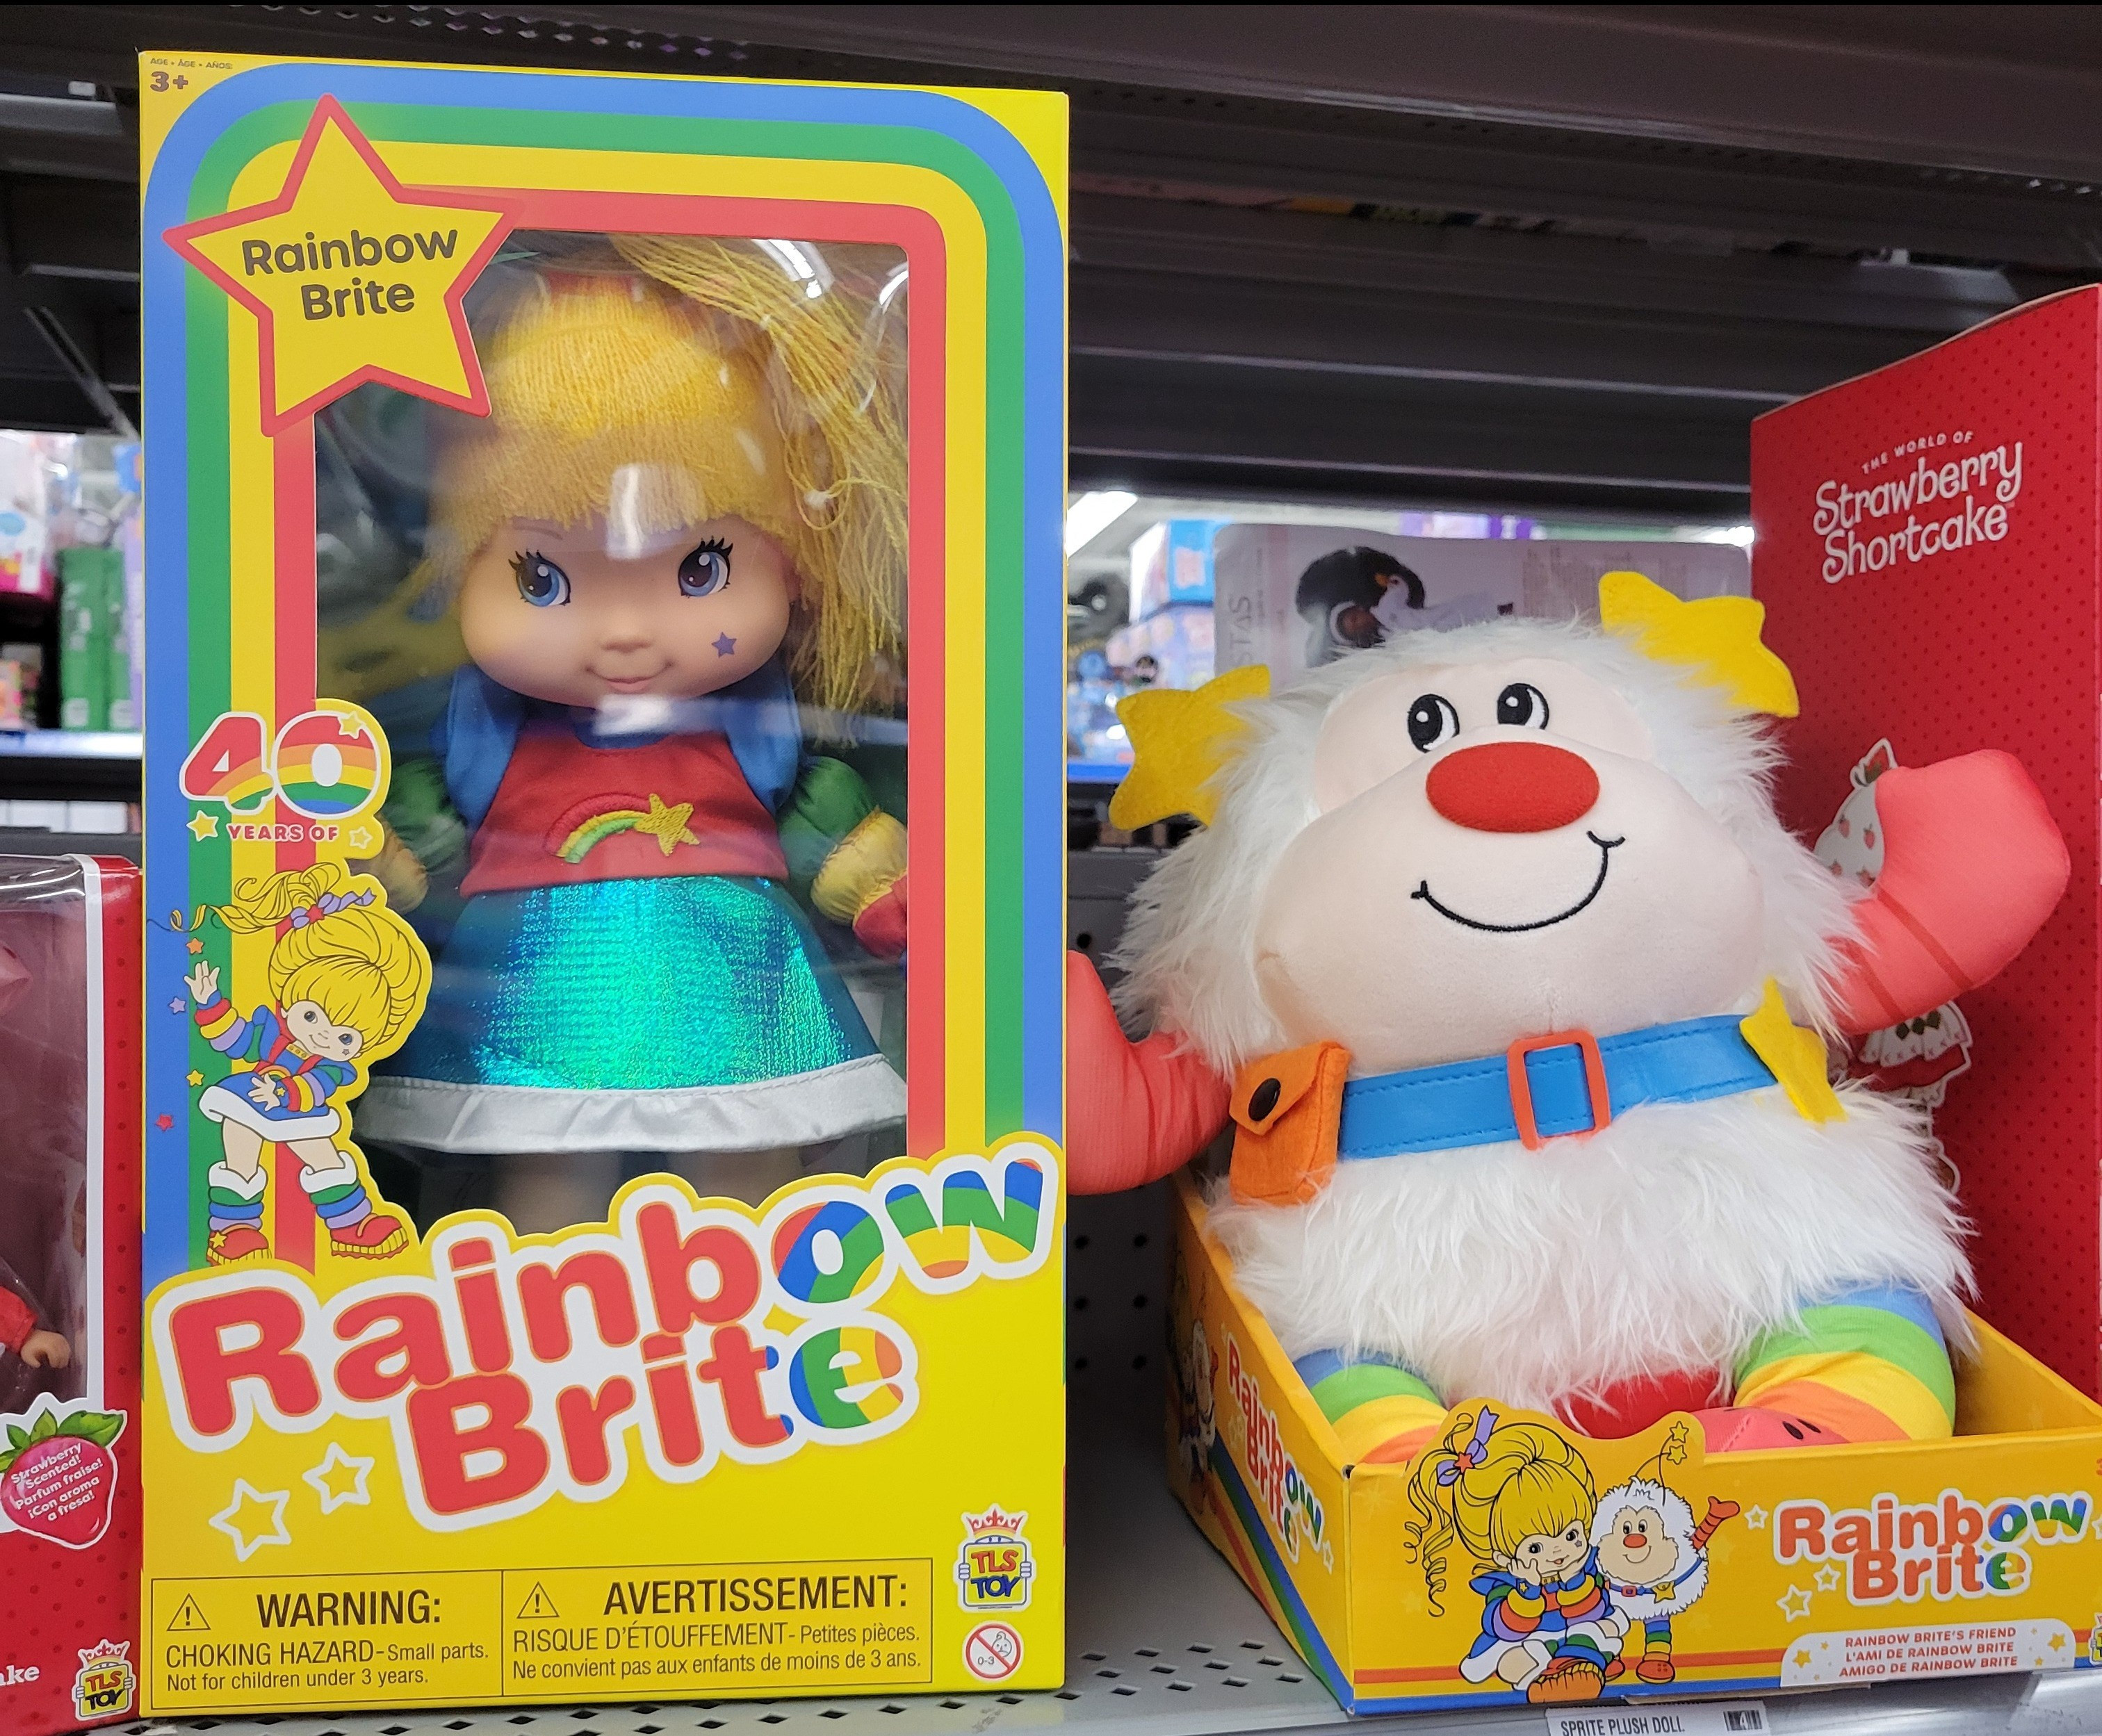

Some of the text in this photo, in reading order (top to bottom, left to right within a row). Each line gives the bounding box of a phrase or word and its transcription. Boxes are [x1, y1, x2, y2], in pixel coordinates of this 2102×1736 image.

[150, 71, 188, 92] 3+
[242, 229, 457, 276] Rainbow
[300, 278, 415, 320] Brite
[1861, 431, 1973, 474] THE WORLD OF
[1813, 442, 2022, 535] Strawberry
[1822, 495, 2008, 583] Shortcake
[181, 713, 380, 817] 40
[228, 825, 339, 840] YEARS OF
[169, 1158, 1043, 1436] Rainbow
[407, 1323, 904, 1516] Brite
[1228, 1336, 1323, 1546] Rainbow
[11, 1443, 82, 1483] Strawberry
[25, 1455, 82, 1489] Scented!
[15, 1458, 104, 1510] Parfum fraise!
[59, 1476, 100, 1502] aroma
[1246, 1423, 1298, 1557] Brite
[47, 1490, 95, 1521] a fresa!
[1779, 1494, 2087, 1558] Rainbow
[971, 1549, 1018, 1573] TLS
[1852, 1544, 2026, 1599] Brite
[603, 1574, 907, 1616] AVERTISSEMENT:
[970, 1573, 1020, 1598] TOY
[256, 1589, 441, 1628] WARNING:
[514, 1628, 598, 1653] RISQUE
[801, 1623, 856, 1644] Petites
[862, 1623, 920, 1646] pièces.
[1846, 1633, 1909, 1648] RAINBOW
[1969, 1627, 2017, 1639] FRIEND
[1846, 1641, 2014, 1662] L'AMI DE RAINBOW BRITE
[166, 1643, 270, 1668] CHOKING
[441, 1642, 489, 1662] parts.
[513, 1649, 921, 1680] Ne convient pas aux enfants de moins de 3 ans.
[977, 1656, 995, 1665] 0-3
[1839, 1656, 2018, 1677] AMIGO DE RAINBOW BRITE
[85, 1670, 122, 1692] TLS
[168, 1669, 428, 1691] Not for children under 3 years.
[85, 1689, 125, 1710] TOY
[1561, 1719, 1606, 1736] SPRITE
[1608, 1717, 1649, 1735] PLUSH
